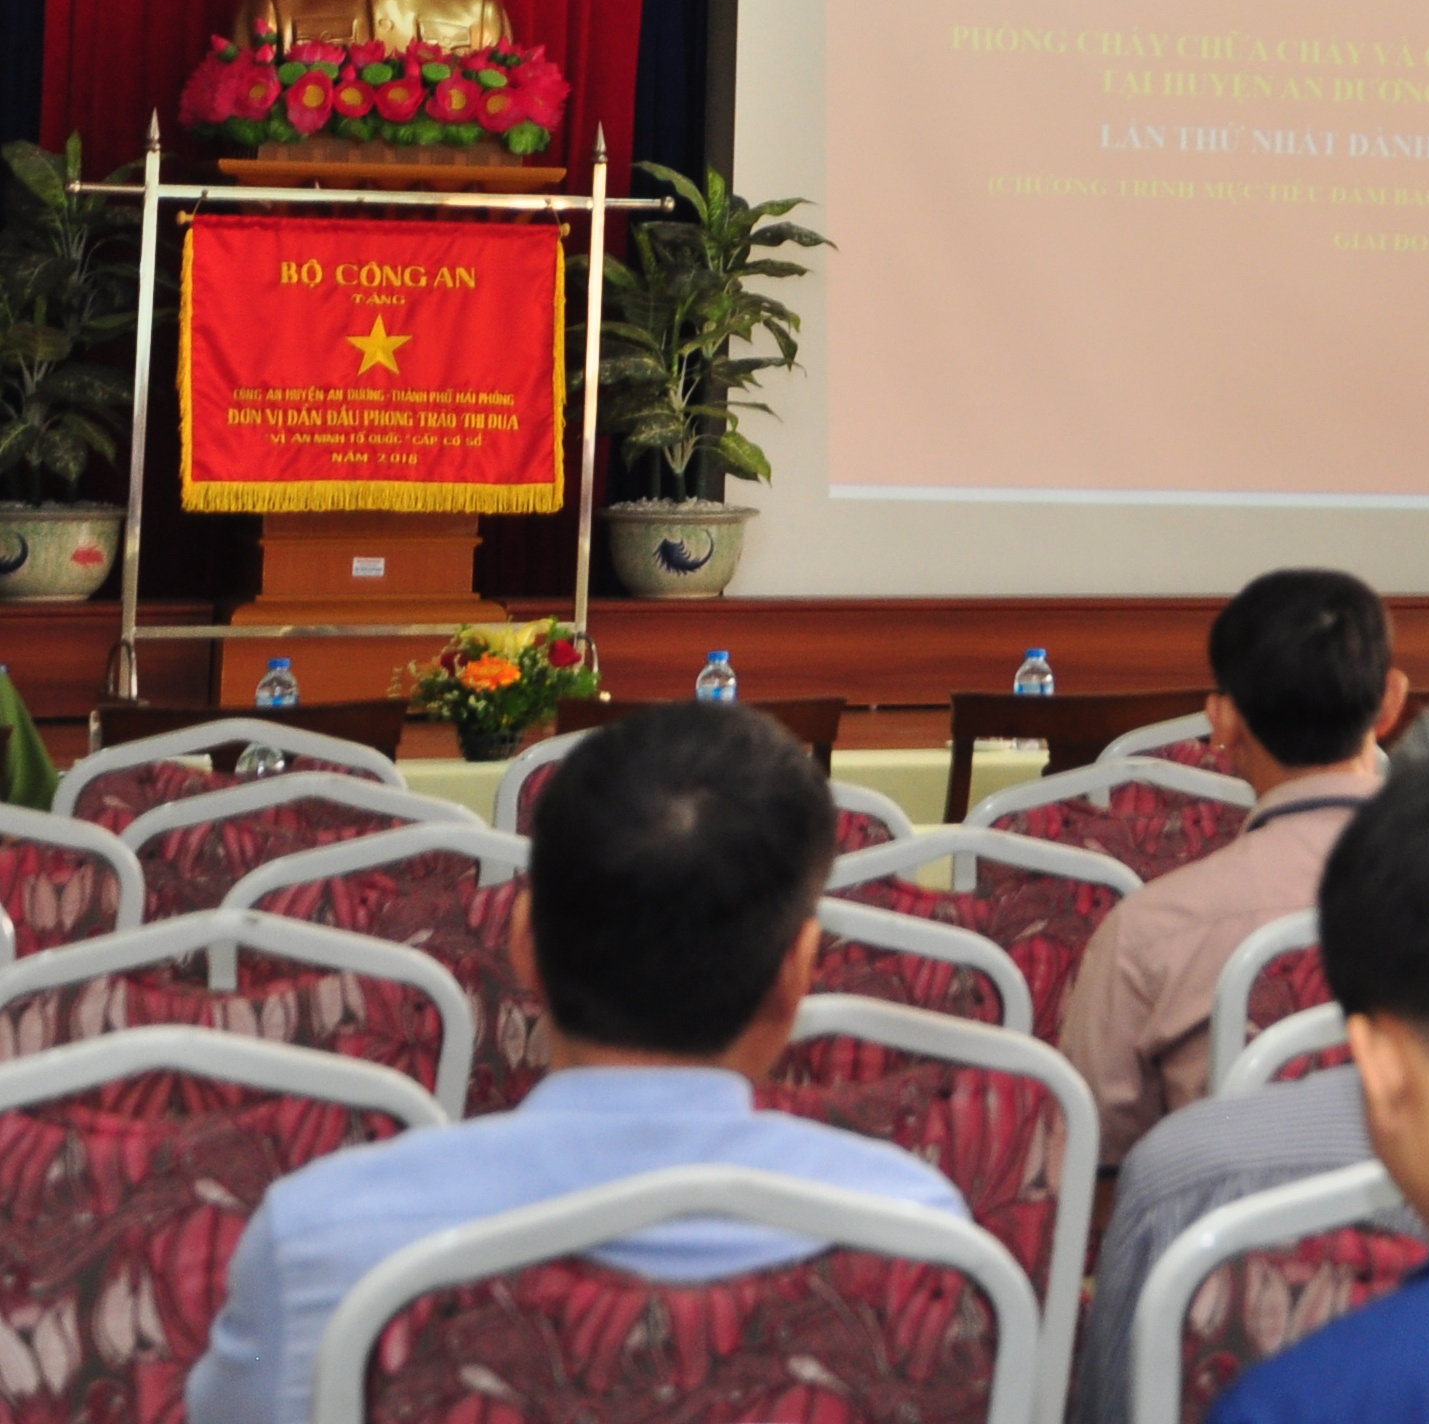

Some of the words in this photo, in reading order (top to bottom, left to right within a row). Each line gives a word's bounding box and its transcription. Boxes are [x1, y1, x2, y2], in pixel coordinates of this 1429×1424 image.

[1281, 76, 1324, 102] AN
[281, 259, 322, 288] BỘ
[335, 261, 427, 287] CÔNG
[433, 266, 475, 288] AN
[364, 410, 413, 426] PHONG
[462, 413, 484, 429] THI
